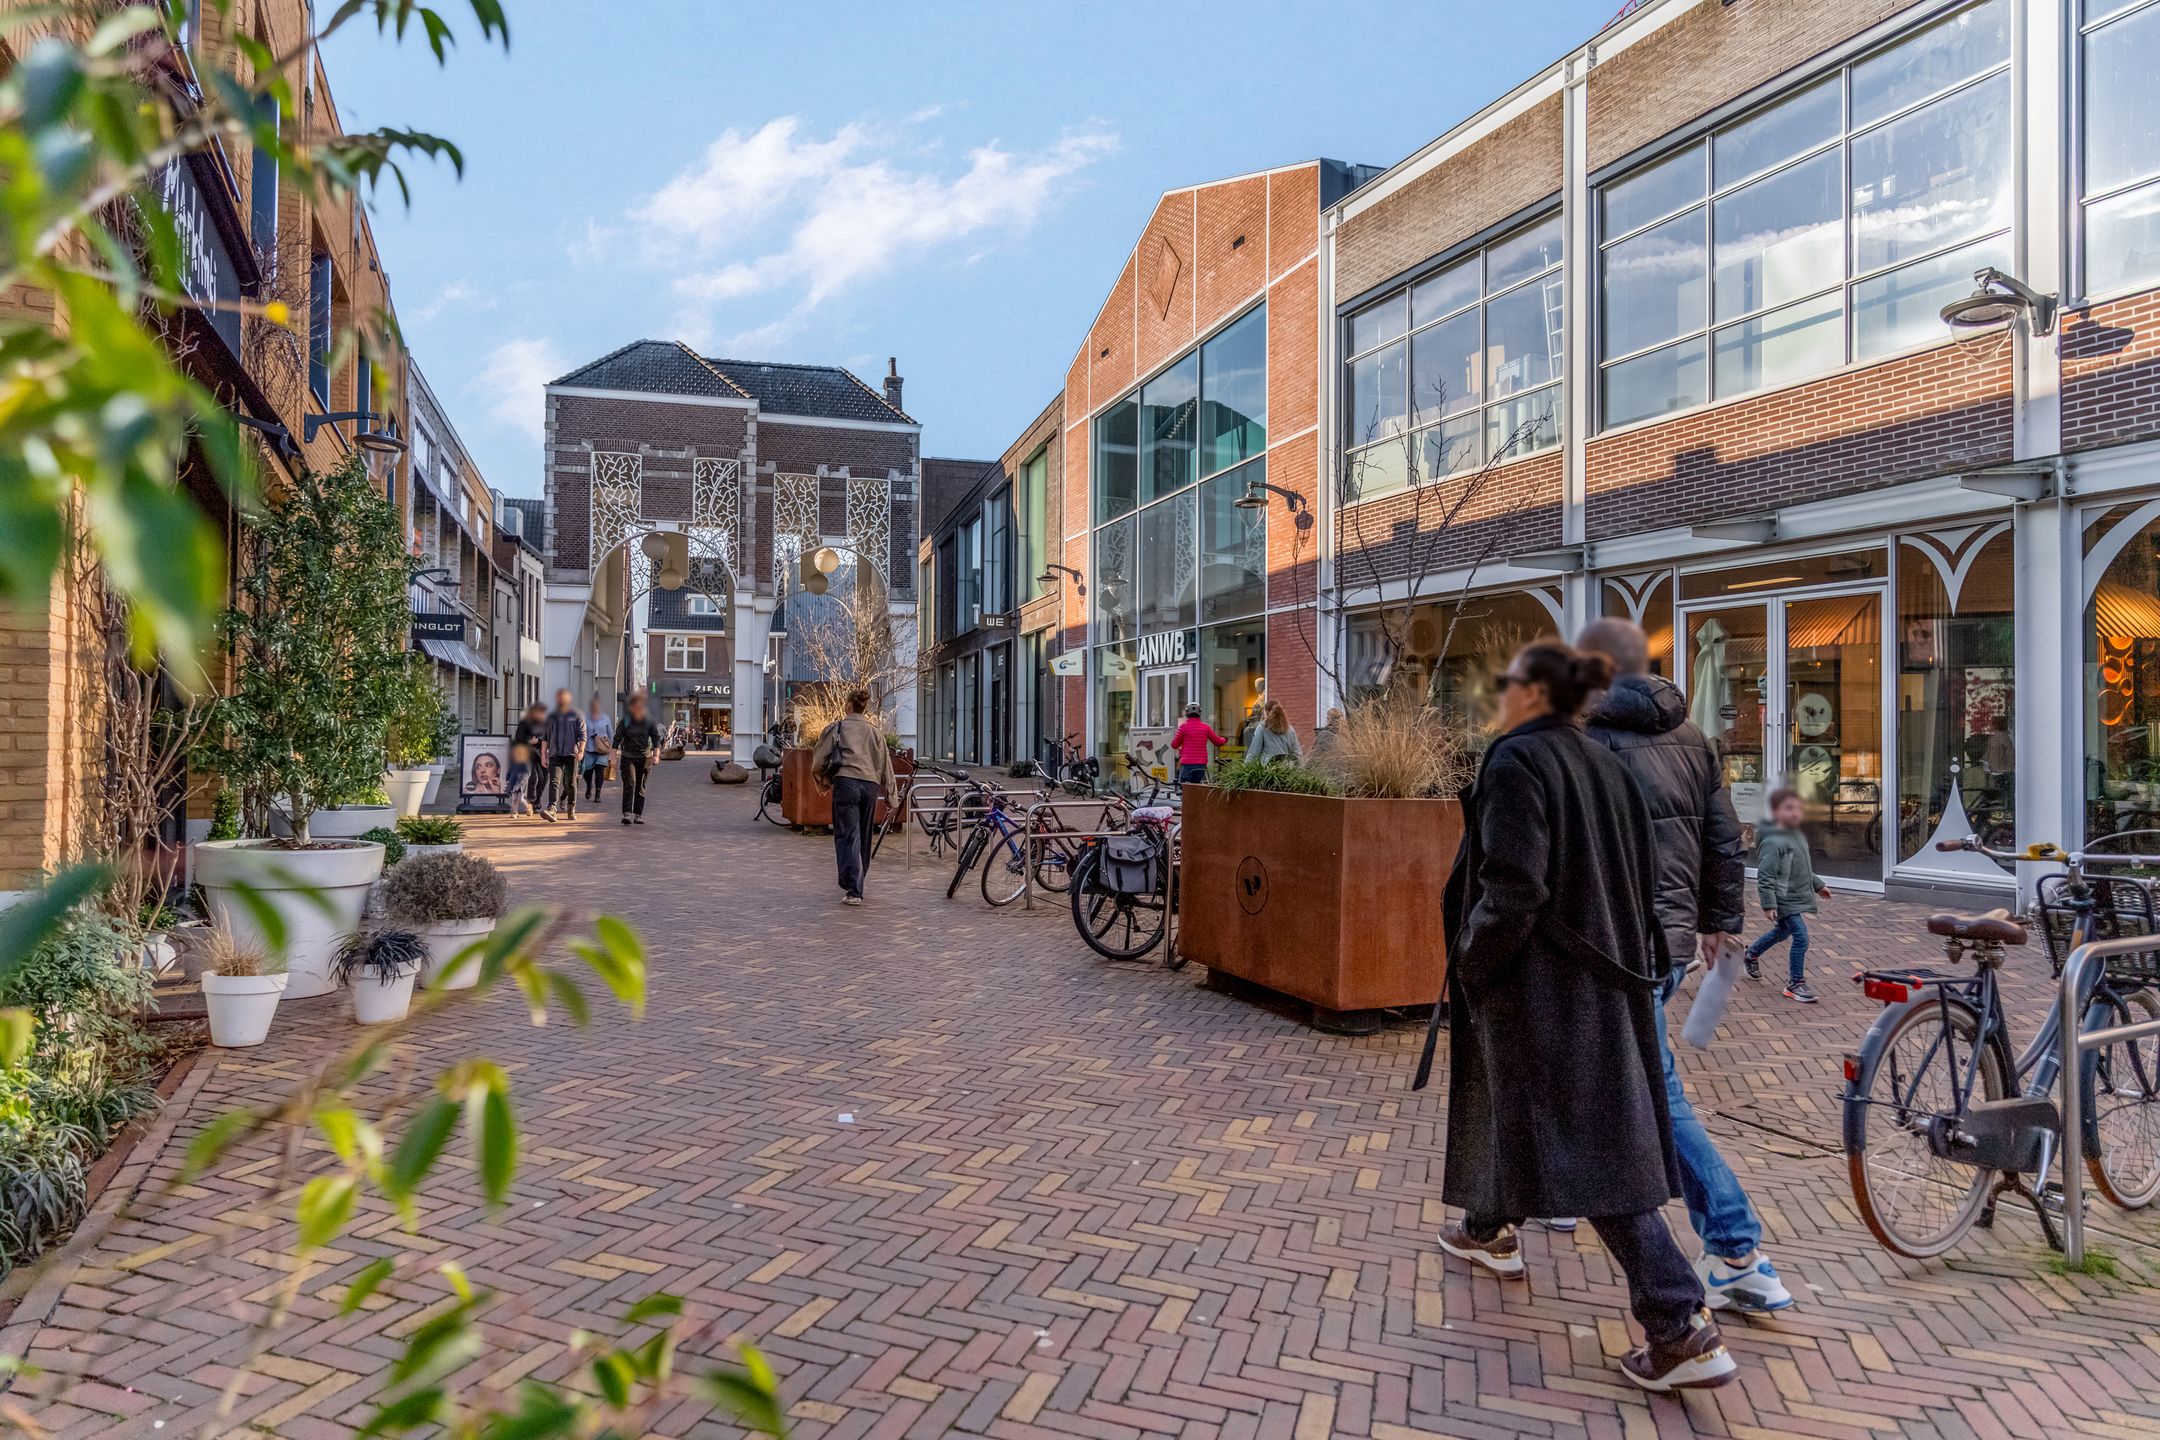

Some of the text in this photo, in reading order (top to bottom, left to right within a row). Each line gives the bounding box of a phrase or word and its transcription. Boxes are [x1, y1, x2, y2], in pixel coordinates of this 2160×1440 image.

[414, 622, 461, 631] INGLOT
[986, 617, 1004, 627] WE
[1138, 631, 1185, 666] ANWB
[694, 685, 730, 695] ZIENG
